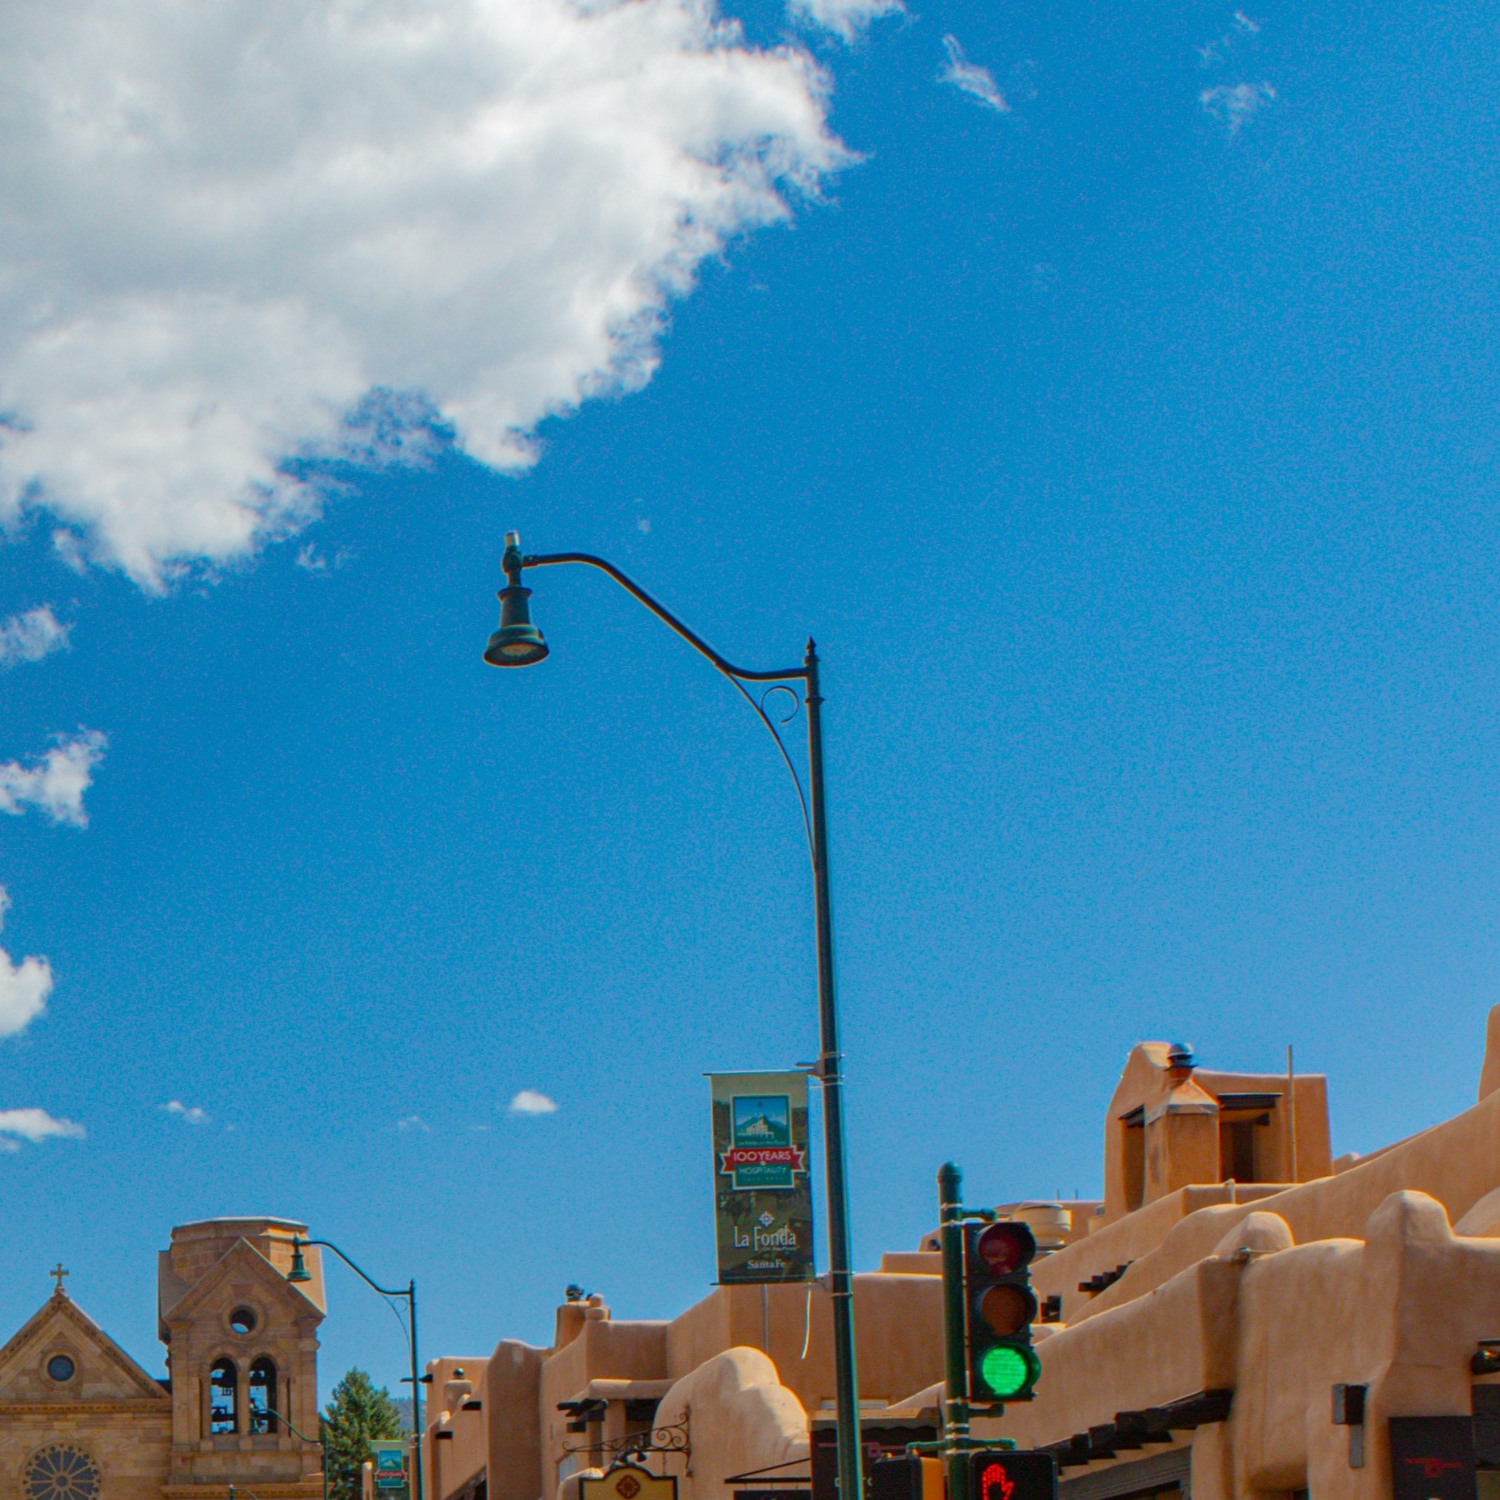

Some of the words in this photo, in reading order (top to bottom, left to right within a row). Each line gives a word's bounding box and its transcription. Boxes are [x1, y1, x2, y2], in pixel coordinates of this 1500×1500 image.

[757, 1151, 791, 1161] YEARS
[734, 1225, 749, 1247] La
[753, 1224, 796, 1251] Fonda
[747, 1260, 774, 1269] Santa
[774, 1259, 786, 1269] Fe
